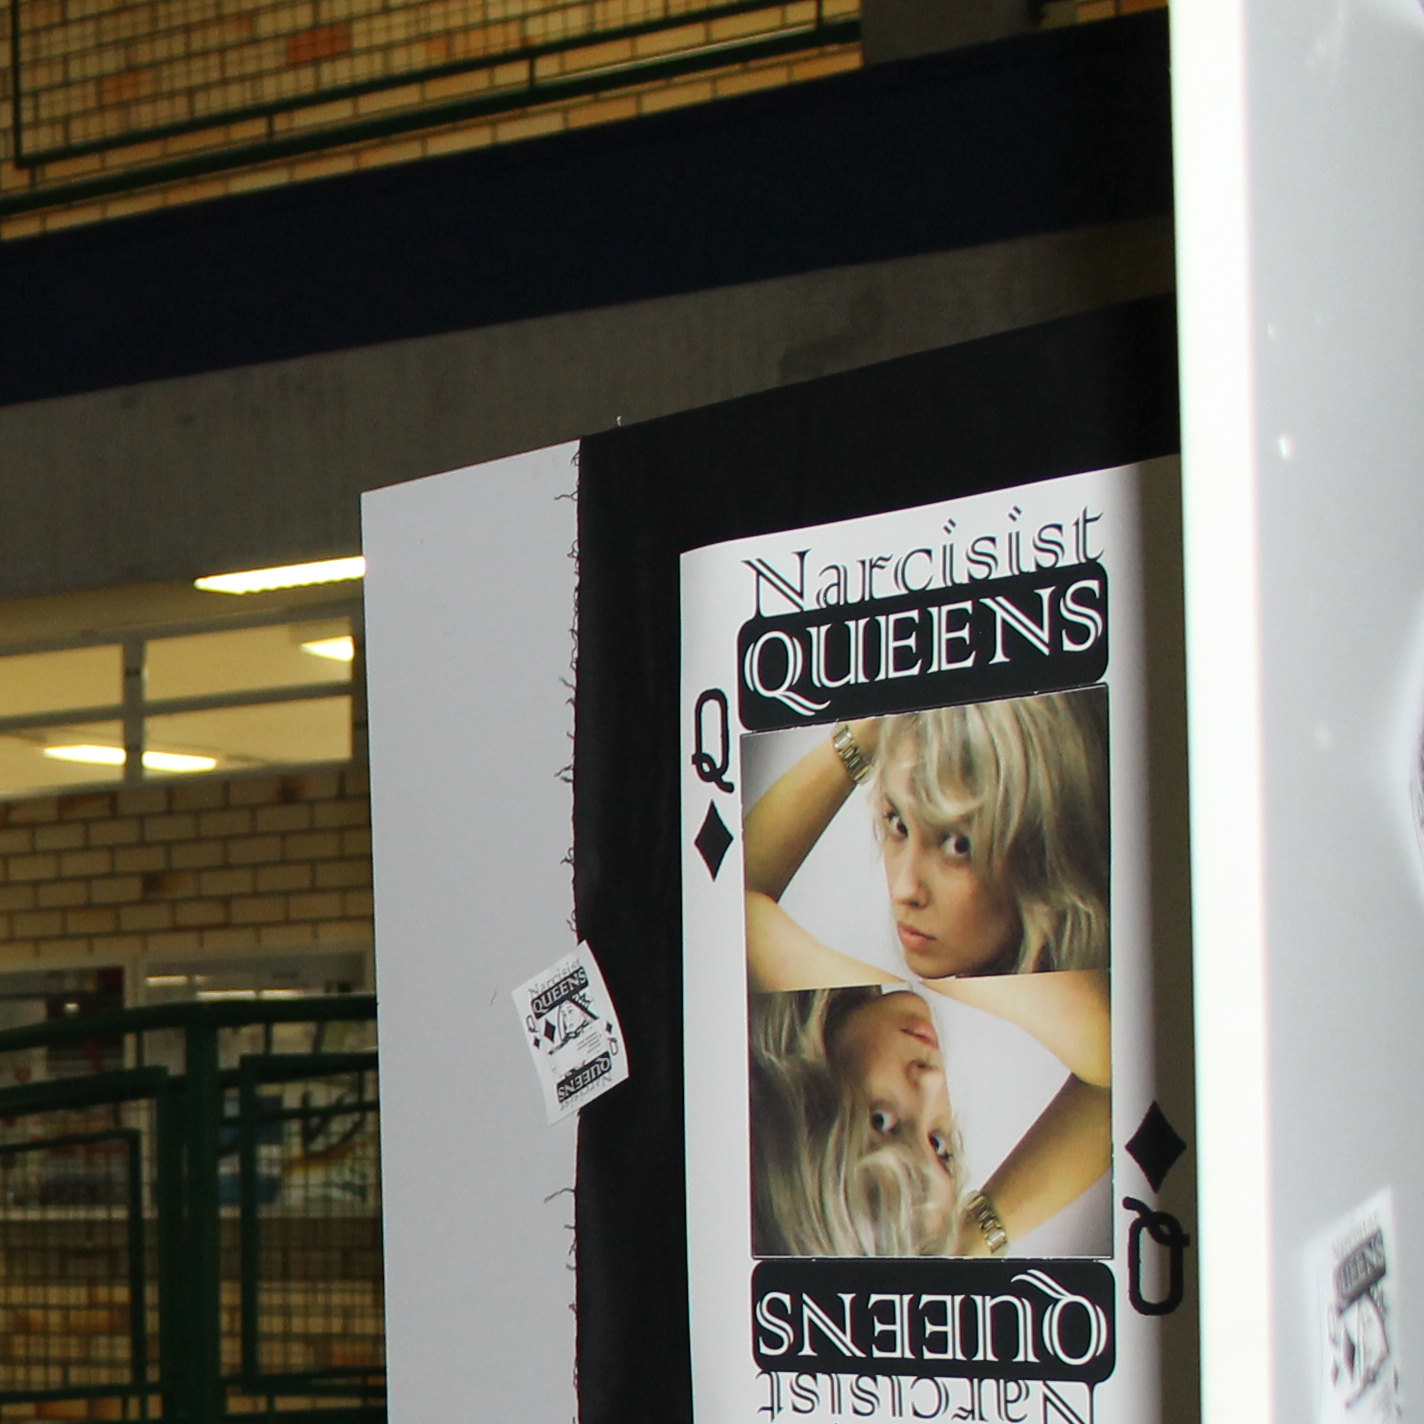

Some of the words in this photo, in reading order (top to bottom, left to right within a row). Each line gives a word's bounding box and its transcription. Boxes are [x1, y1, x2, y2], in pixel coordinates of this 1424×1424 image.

[741, 505, 1104, 618] Narcisist
[744, 578, 1104, 716] QUEENS
[692, 688, 735, 793] Q
[533, 968, 587, 1014] QUEENS
[557, 1055, 611, 1101] QUEENS
[1122, 1196, 1190, 1317] Q
[755, 1269, 1109, 1366] QUEENS
